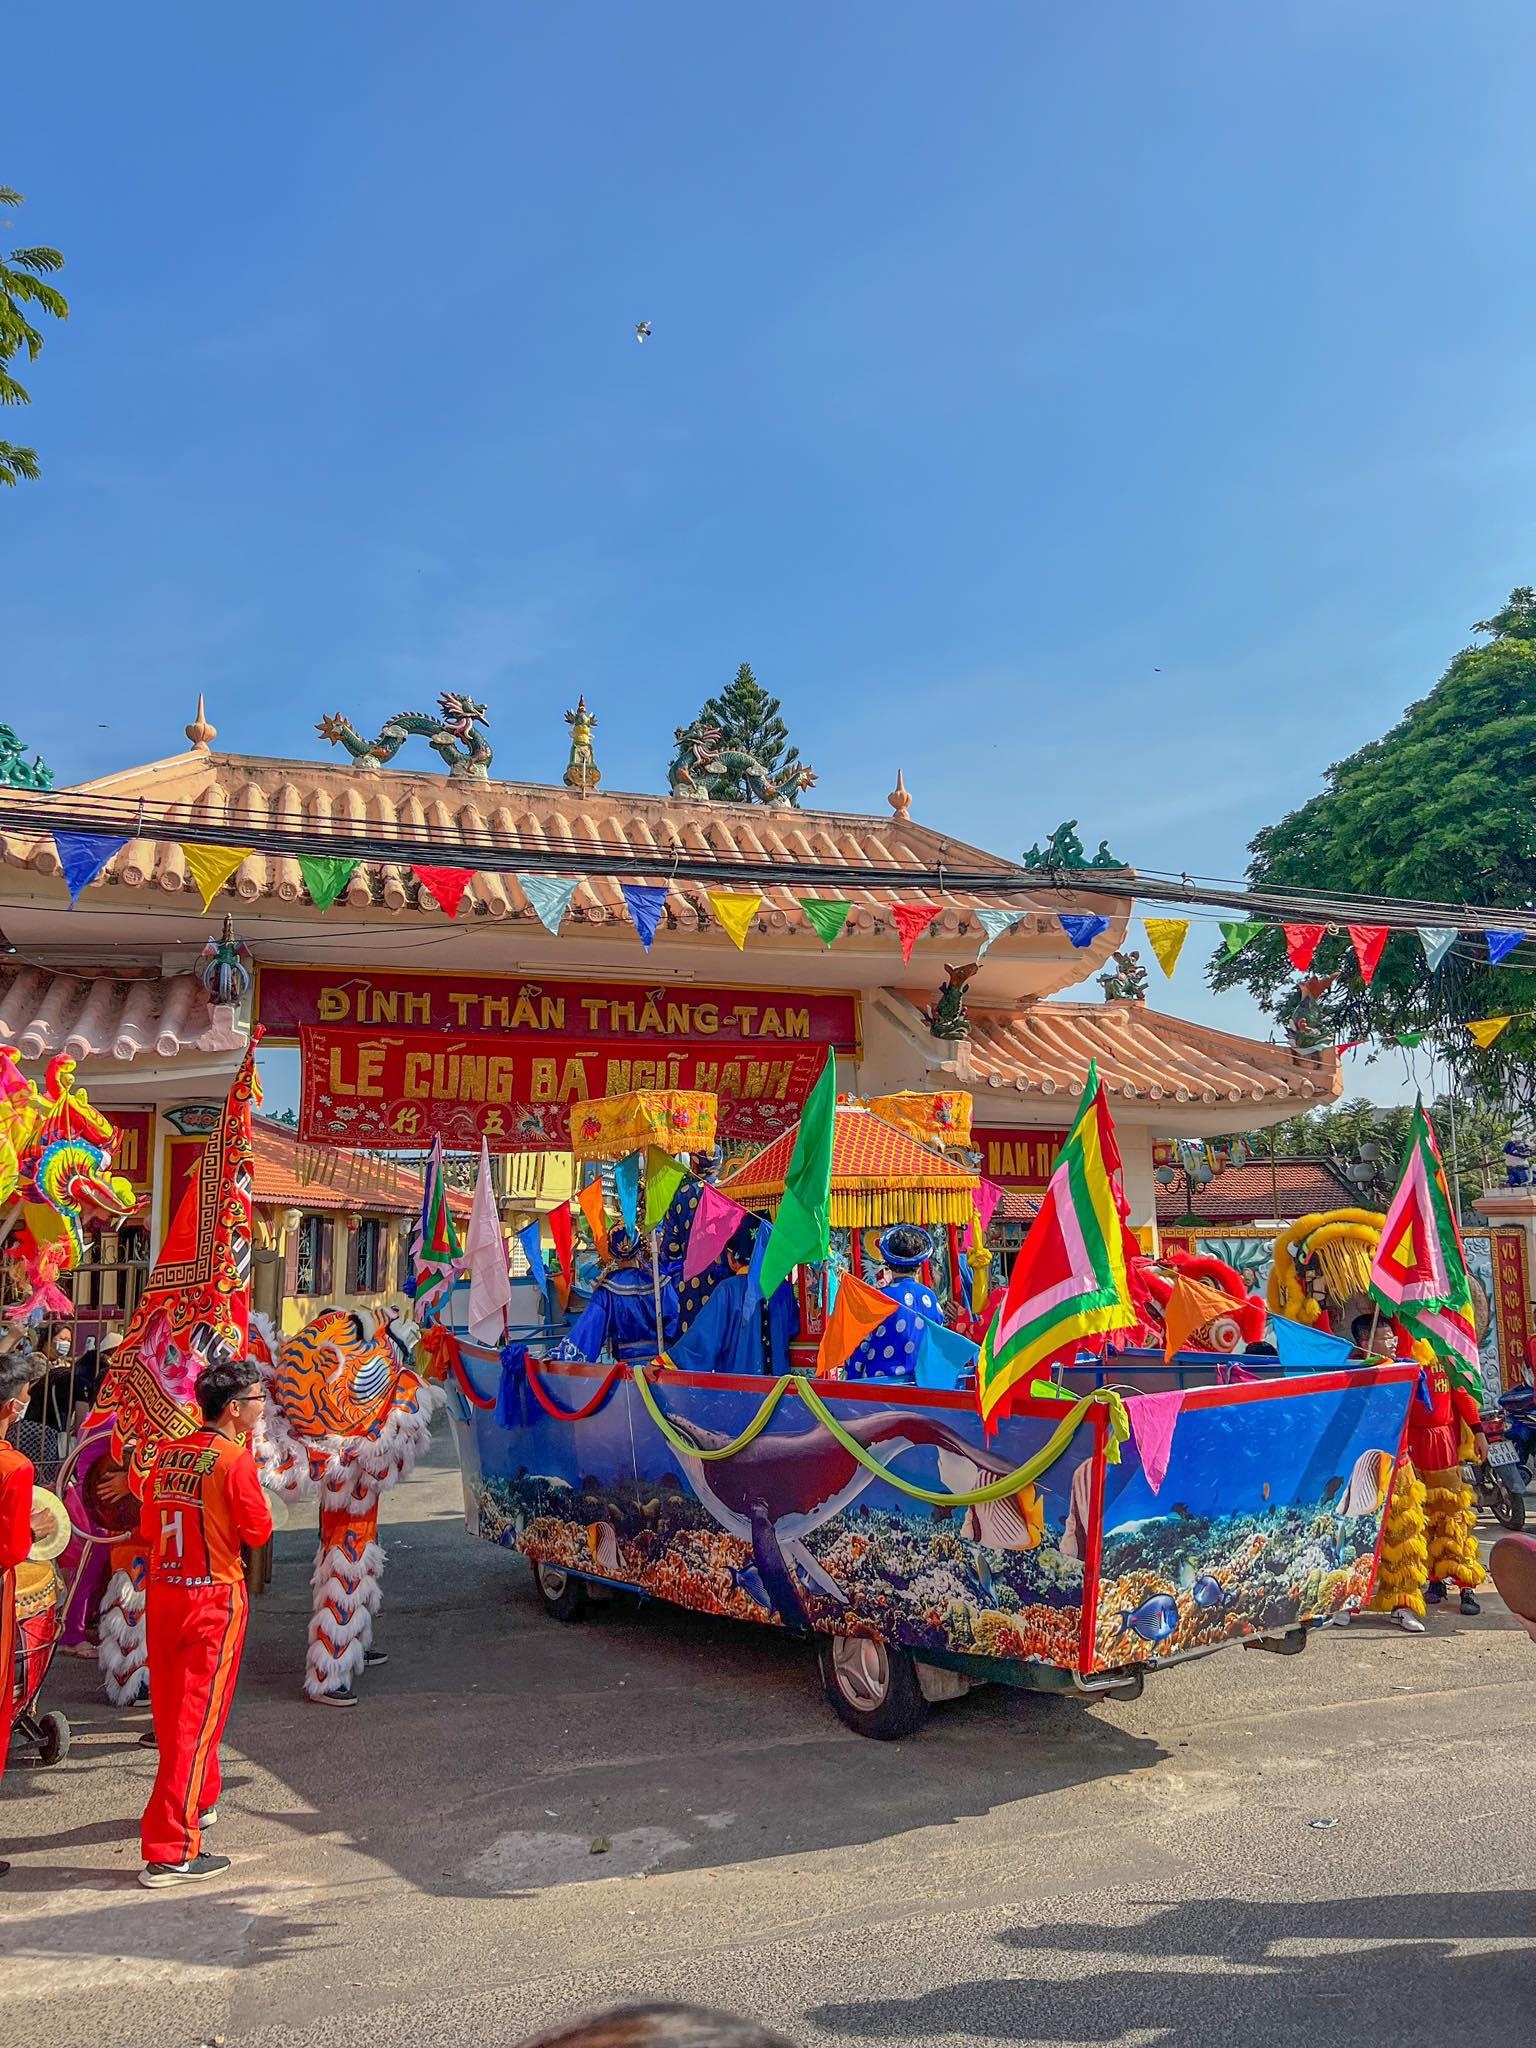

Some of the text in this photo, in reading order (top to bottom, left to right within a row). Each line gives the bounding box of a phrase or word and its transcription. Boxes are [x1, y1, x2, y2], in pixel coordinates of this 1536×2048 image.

[330, 1038, 404, 1097] LỄ
[404, 1042, 514, 1102] CÚNG
[605, 1052, 689, 1097] NGŨ
[481, 1109, 506, 1136] 五
